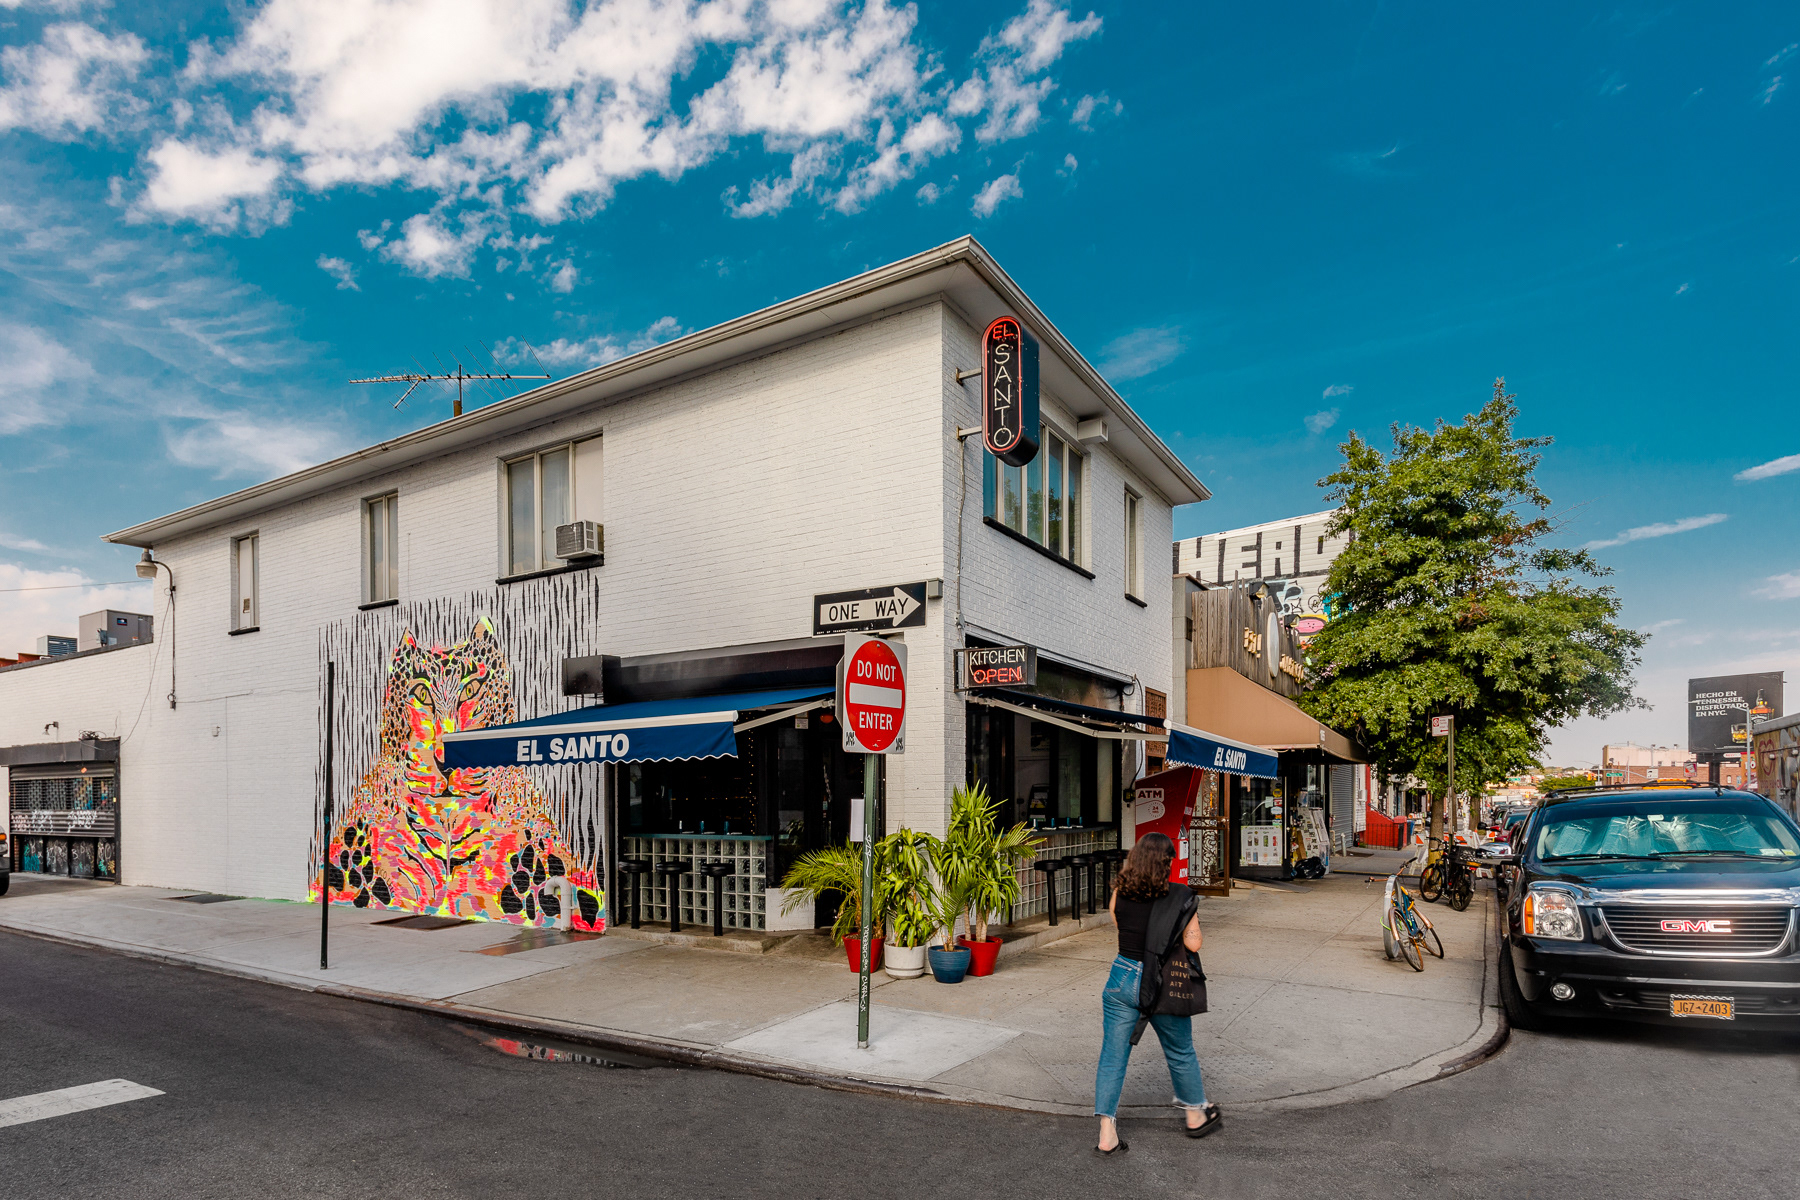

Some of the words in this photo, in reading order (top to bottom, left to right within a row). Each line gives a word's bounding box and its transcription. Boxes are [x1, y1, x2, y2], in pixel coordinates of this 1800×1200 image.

[992, 323, 1014, 340] EL
[993, 343, 1012, 447] SANTO
[828, 602, 860, 622] ONE
[875, 598, 909, 618] WAY
[969, 648, 1026, 666] KITCHEN
[857, 659, 873, 679] DO
[876, 663, 897, 682] NOT
[1695, 691, 1724, 699] HECHO
[1695, 702, 1749, 711] DISFRUTADO
[858, 711, 893, 731] ENTER
[516, 739, 543, 762] EL
[549, 733, 630, 761] SANTO
[1214, 746, 1225, 767] EL
[1224, 749, 1247, 771] SANTO
[1138, 790, 1163, 799] ATM
[1660, 919, 1732, 933] GMC
[1171, 960, 1188, 969] YALE
[1677, 1001, 1695, 1013] JGZ
[1702, 1003, 1728, 1015] 2403
